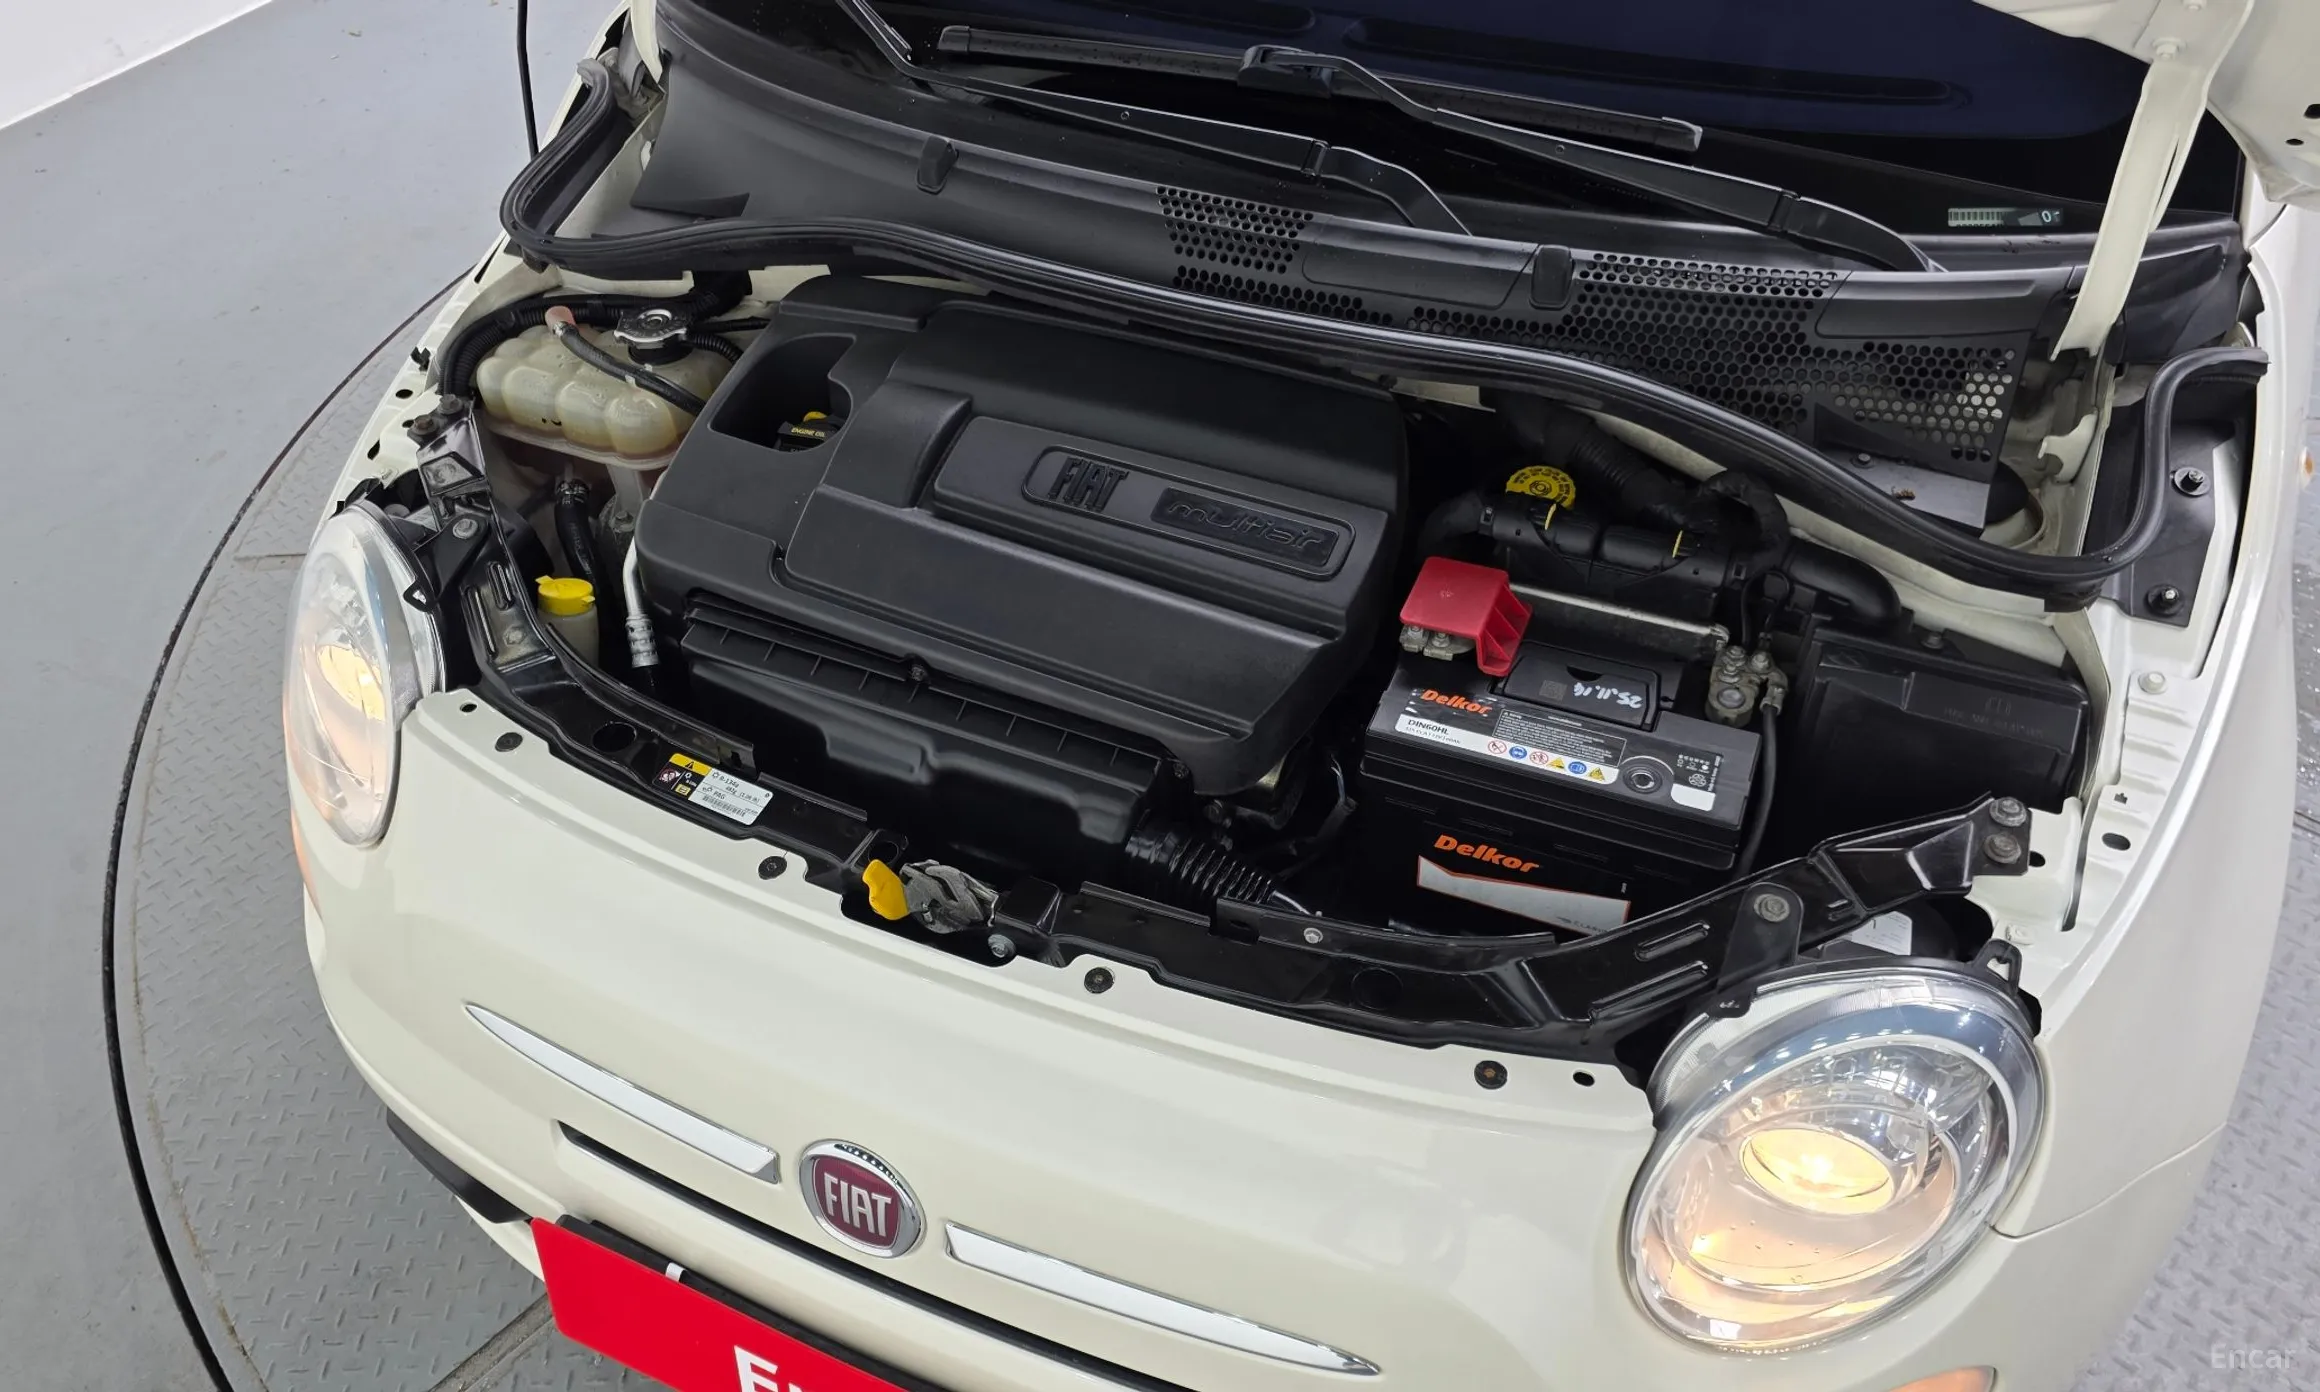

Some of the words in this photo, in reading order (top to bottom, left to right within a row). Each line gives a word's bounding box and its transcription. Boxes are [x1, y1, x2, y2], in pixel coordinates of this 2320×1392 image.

[791, 427, 814, 436] ENGINE
[1047, 456, 1129, 512] FIAT
[1420, 689, 1493, 714] Delkor
[1407, 719, 1449, 735] DIN60HL
[1433, 834, 1541, 873] Delkor
[823, 1172, 892, 1238] FIAT
